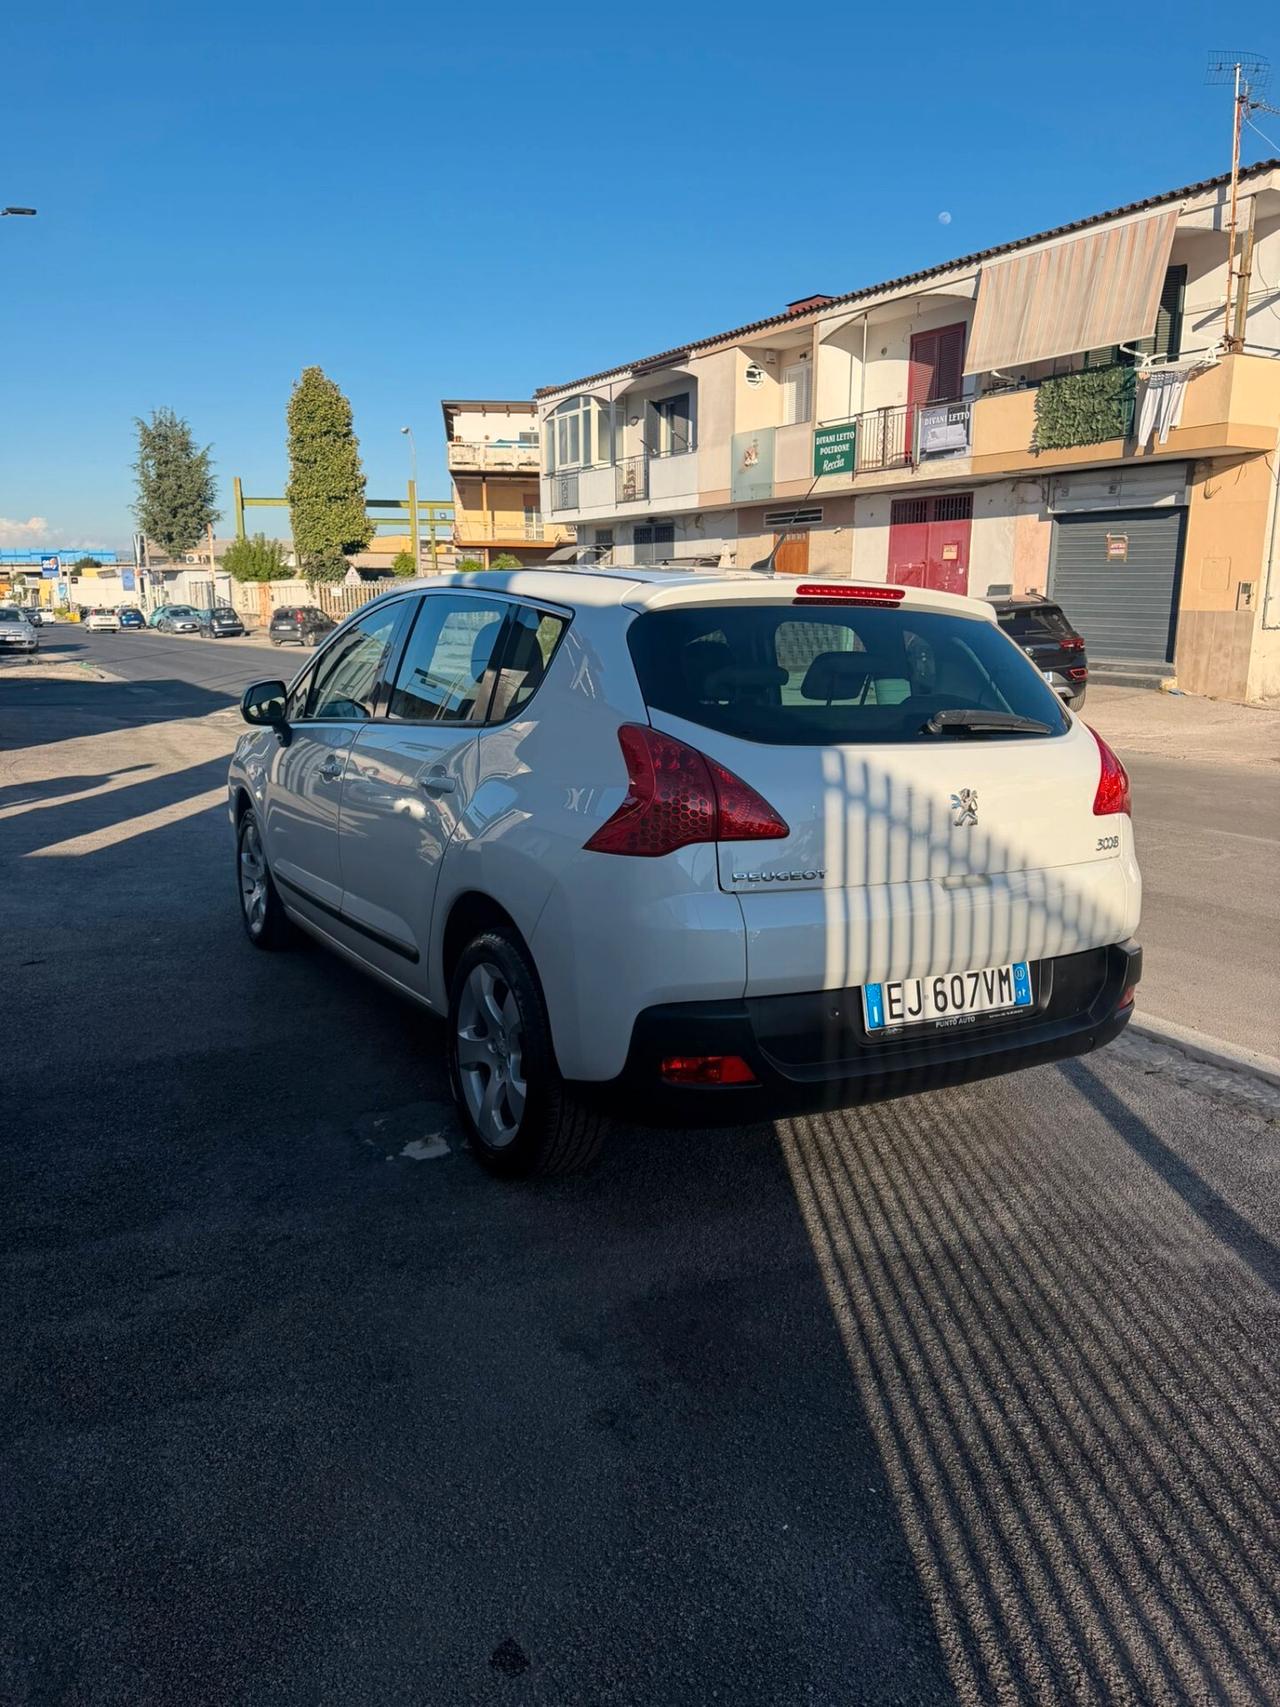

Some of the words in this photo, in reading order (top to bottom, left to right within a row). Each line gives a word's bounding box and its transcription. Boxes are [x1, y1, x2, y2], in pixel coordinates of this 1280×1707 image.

[924, 414, 947, 426] DIVANI
[949, 411, 970, 422] LETTO
[816, 434, 836, 445] DIVANI
[836, 431, 855, 442] LETTO
[820, 443, 850, 455] POLTRONE
[1096, 835, 1119, 851] 3008
[732, 869, 827, 883] PEUGEOT
[935, 1018, 957, 1029] PUNTO
[958, 1015, 976, 1025] AUTO
